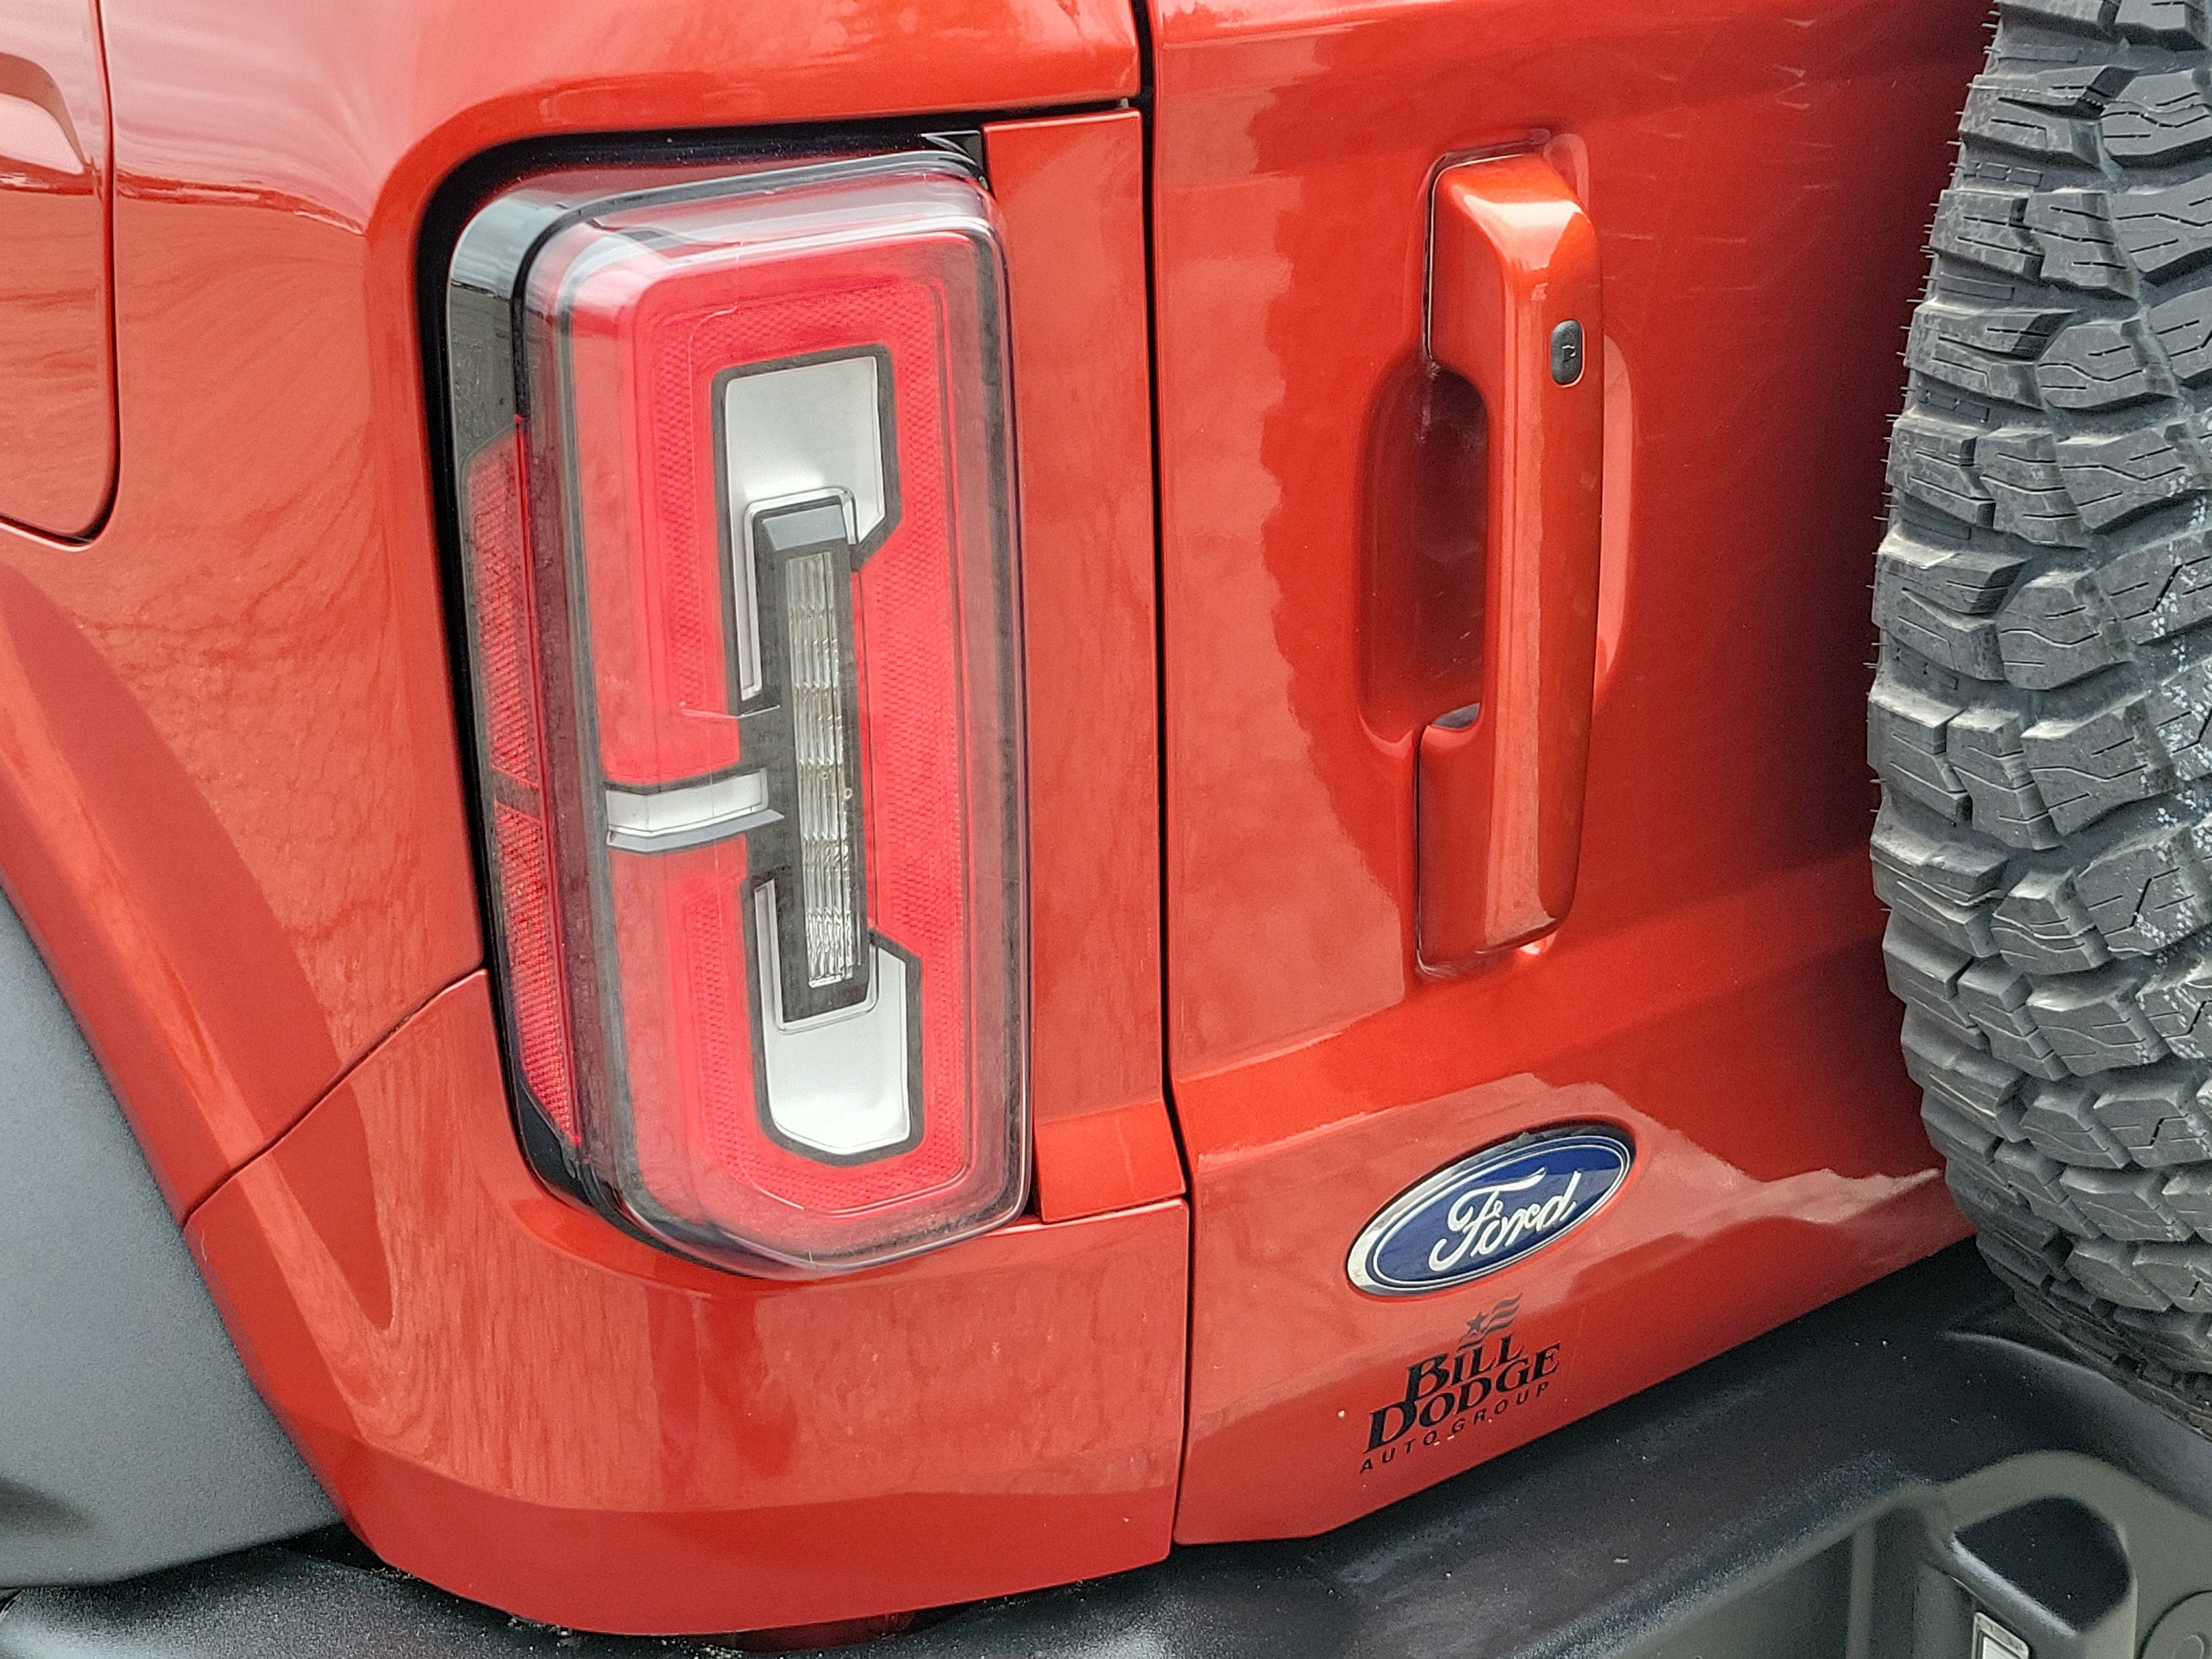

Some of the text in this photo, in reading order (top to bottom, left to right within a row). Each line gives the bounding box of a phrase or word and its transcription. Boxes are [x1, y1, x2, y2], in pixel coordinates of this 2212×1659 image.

[1429, 1167, 1582, 1271] Ford
[1363, 1342, 1560, 1453] DODGE
[1406, 1334, 1523, 1401] BILL
[1360, 1381, 1549, 1473] AUTO GROUP
